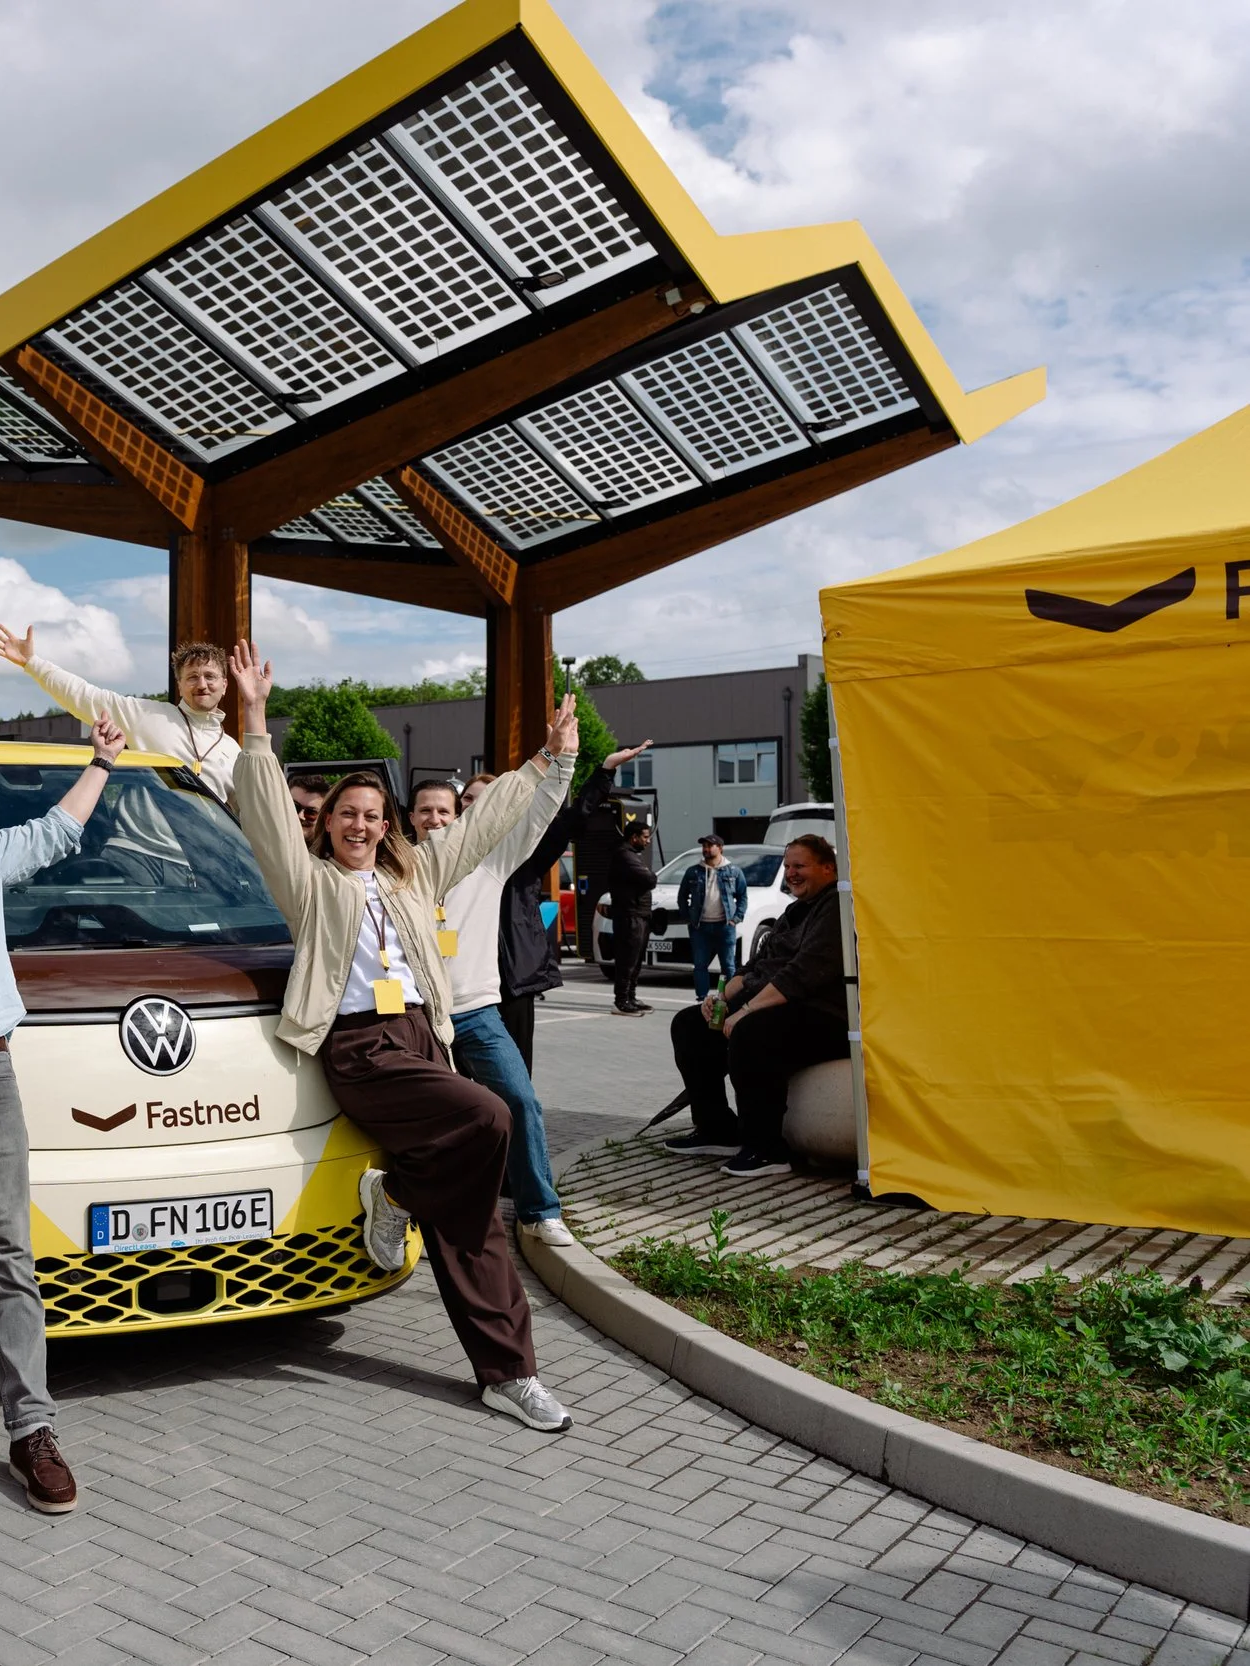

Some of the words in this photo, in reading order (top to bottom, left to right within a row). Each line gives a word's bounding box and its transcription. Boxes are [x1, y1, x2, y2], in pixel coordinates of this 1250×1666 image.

[146, 1095, 260, 1129] Fastned
[97, 1230, 104, 1240] D
[112, 1210, 130, 1241] D
[150, 1204, 188, 1237] FN
[195, 1197, 268, 1233] 106E
